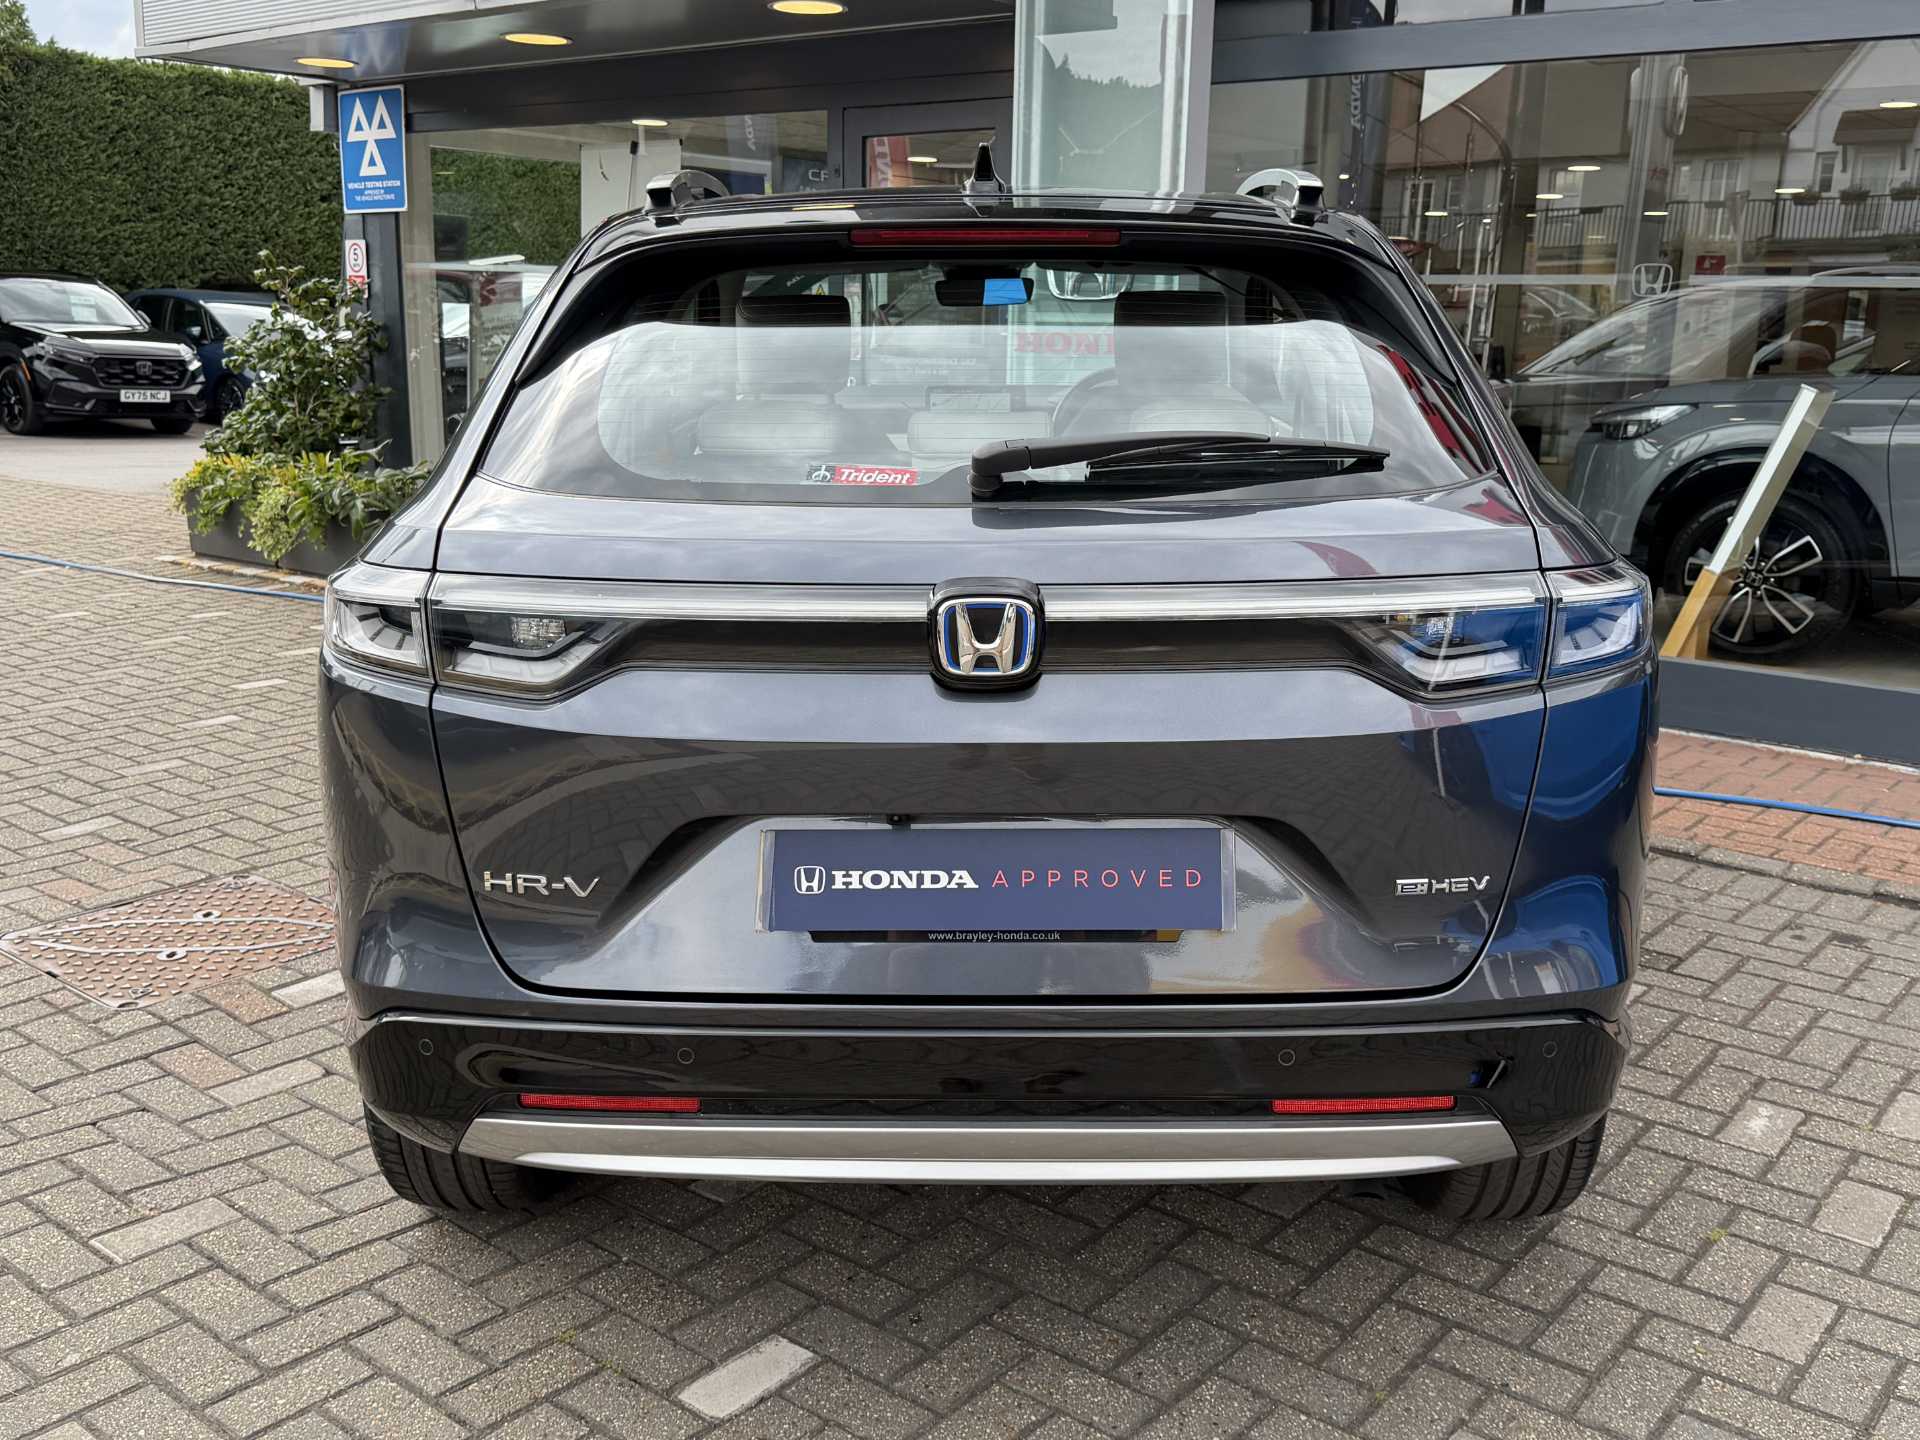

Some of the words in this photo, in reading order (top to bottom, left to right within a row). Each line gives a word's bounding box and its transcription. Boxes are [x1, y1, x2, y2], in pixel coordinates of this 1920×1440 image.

[839, 467, 911, 484] Trident
[483, 870, 600, 898] HR-V
[831, 869, 979, 890] HONDA
[991, 868, 1203, 889] APPROVED
[927, 930, 1061, 943] www.brayley-honda.co.uk
